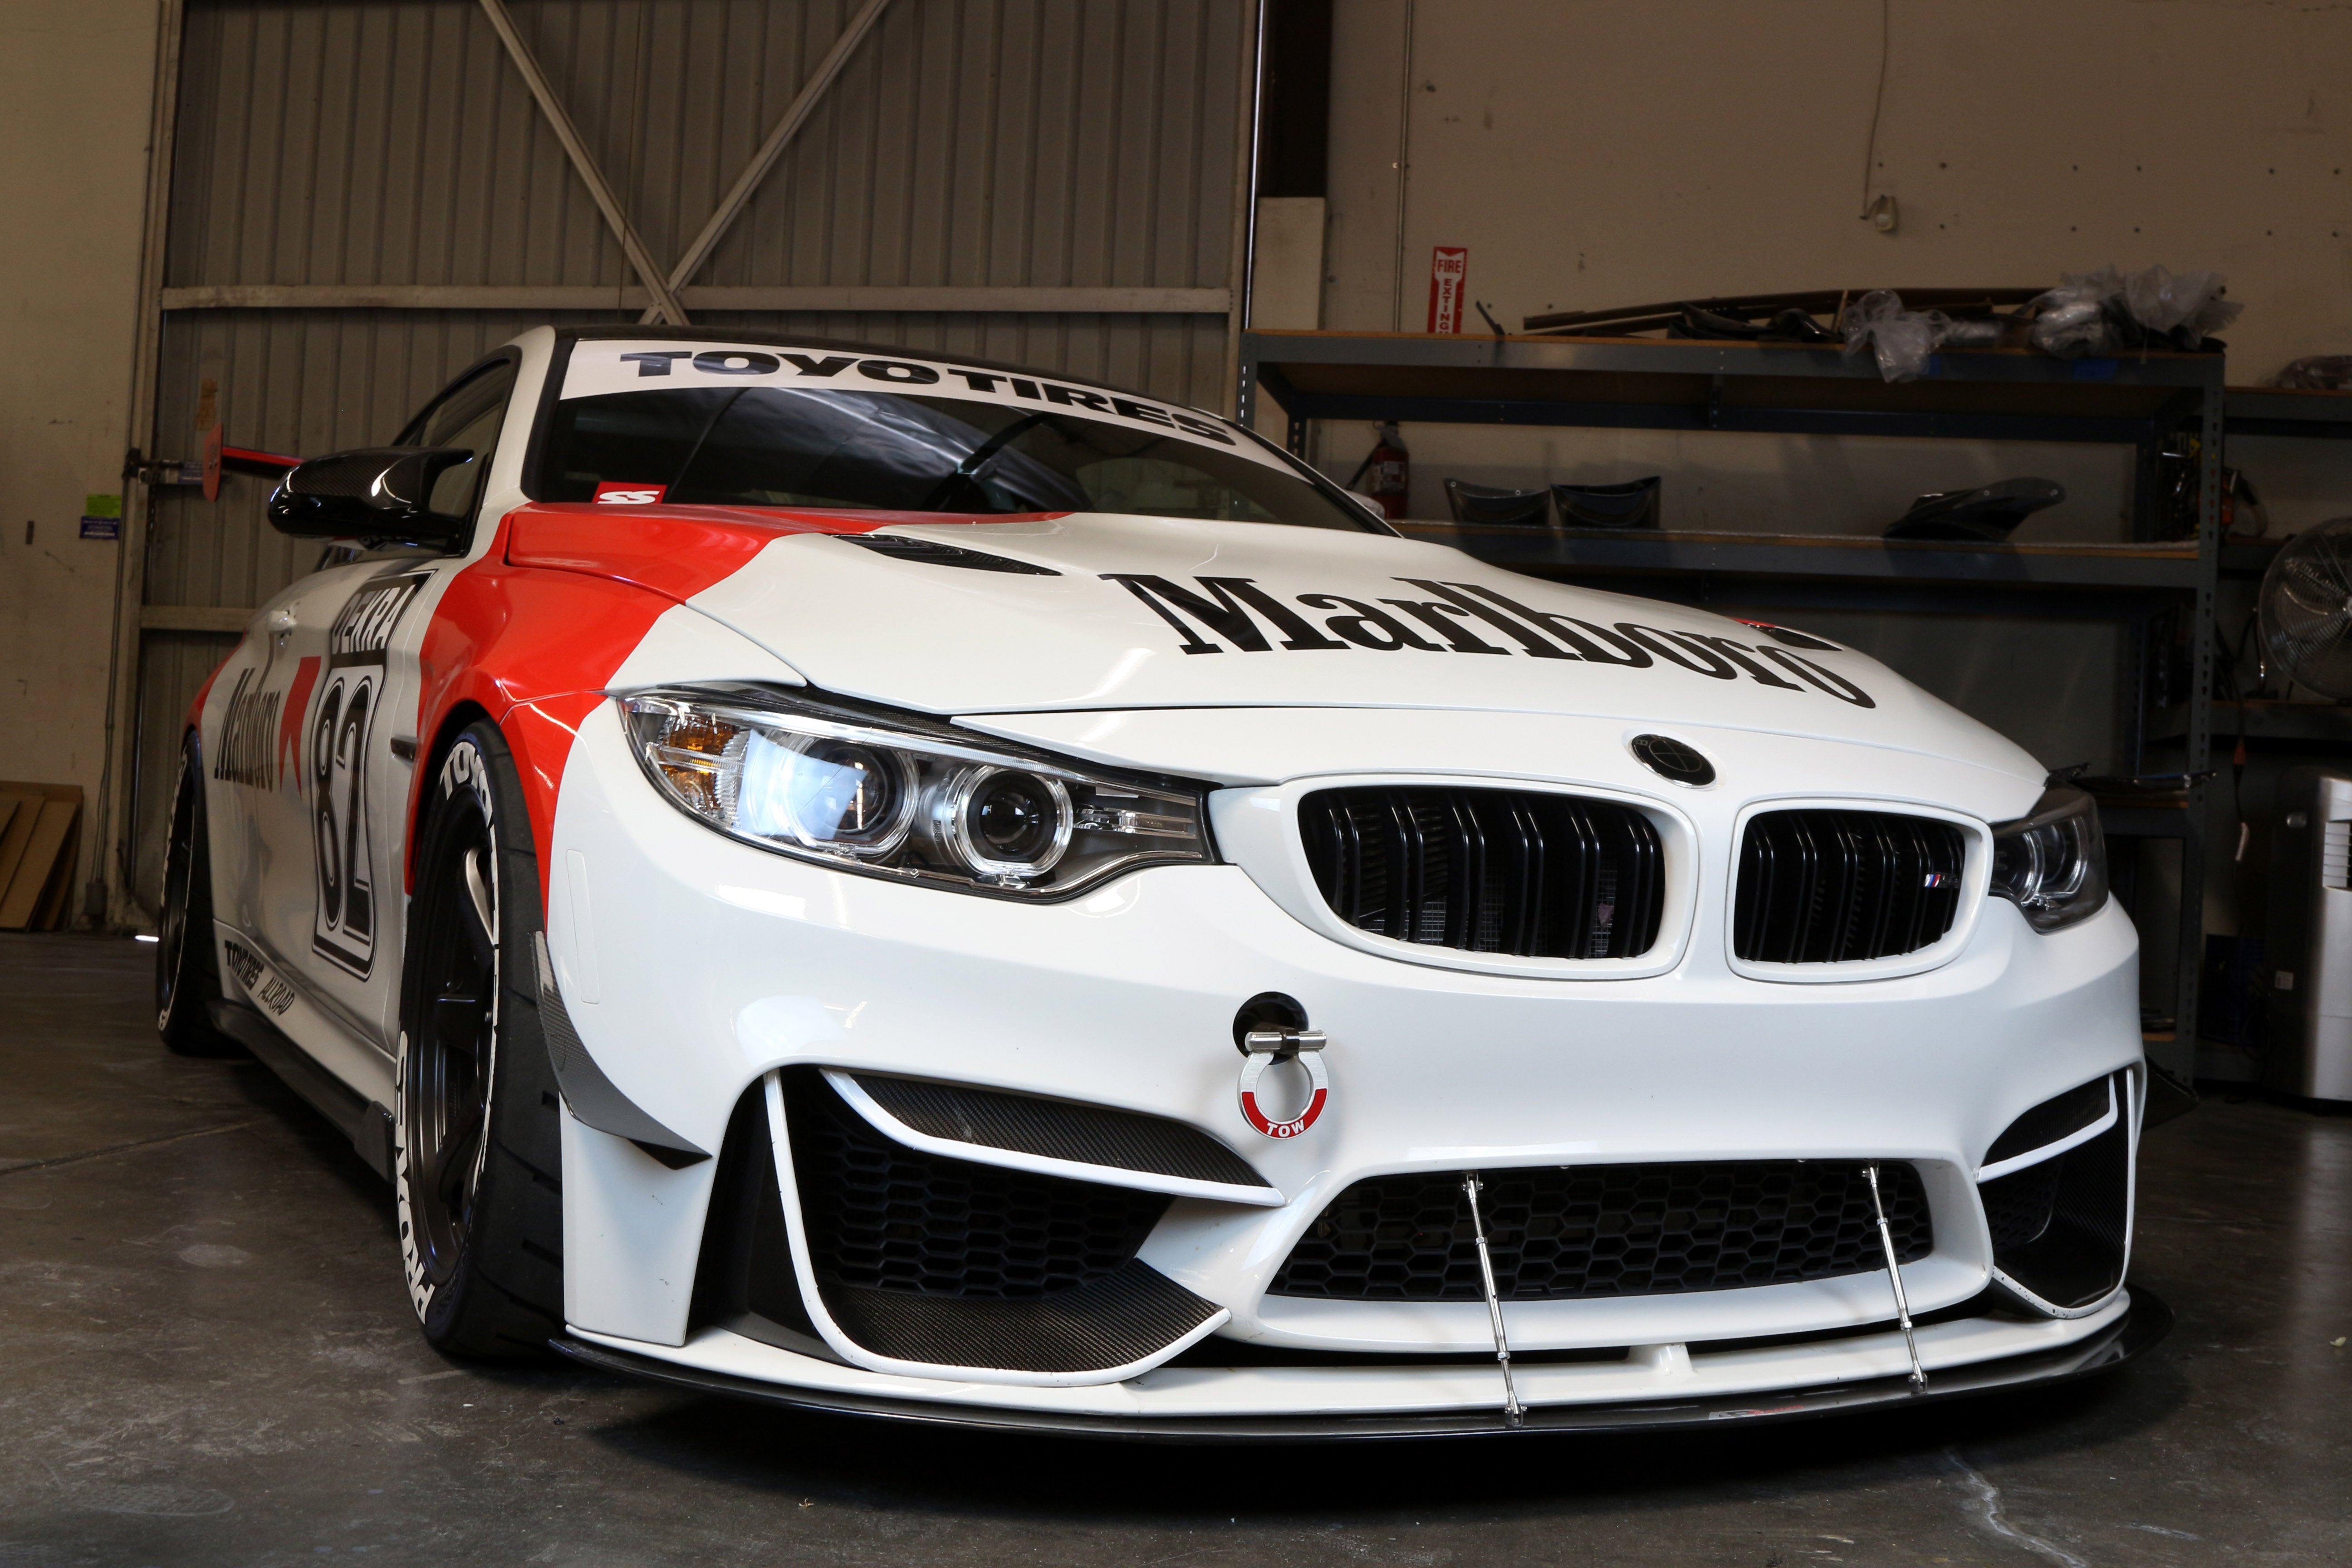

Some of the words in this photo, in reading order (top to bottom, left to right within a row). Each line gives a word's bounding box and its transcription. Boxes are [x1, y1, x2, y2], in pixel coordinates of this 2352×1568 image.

[1437, 259, 1461, 273] FIRE
[1439, 278, 1452, 333] EXTING
[332, 584, 416, 654] DEKRA
[1097, 573, 1877, 709] Marlboro
[315, 675, 373, 943] 82
[1266, 1119, 1305, 1138] TOW
